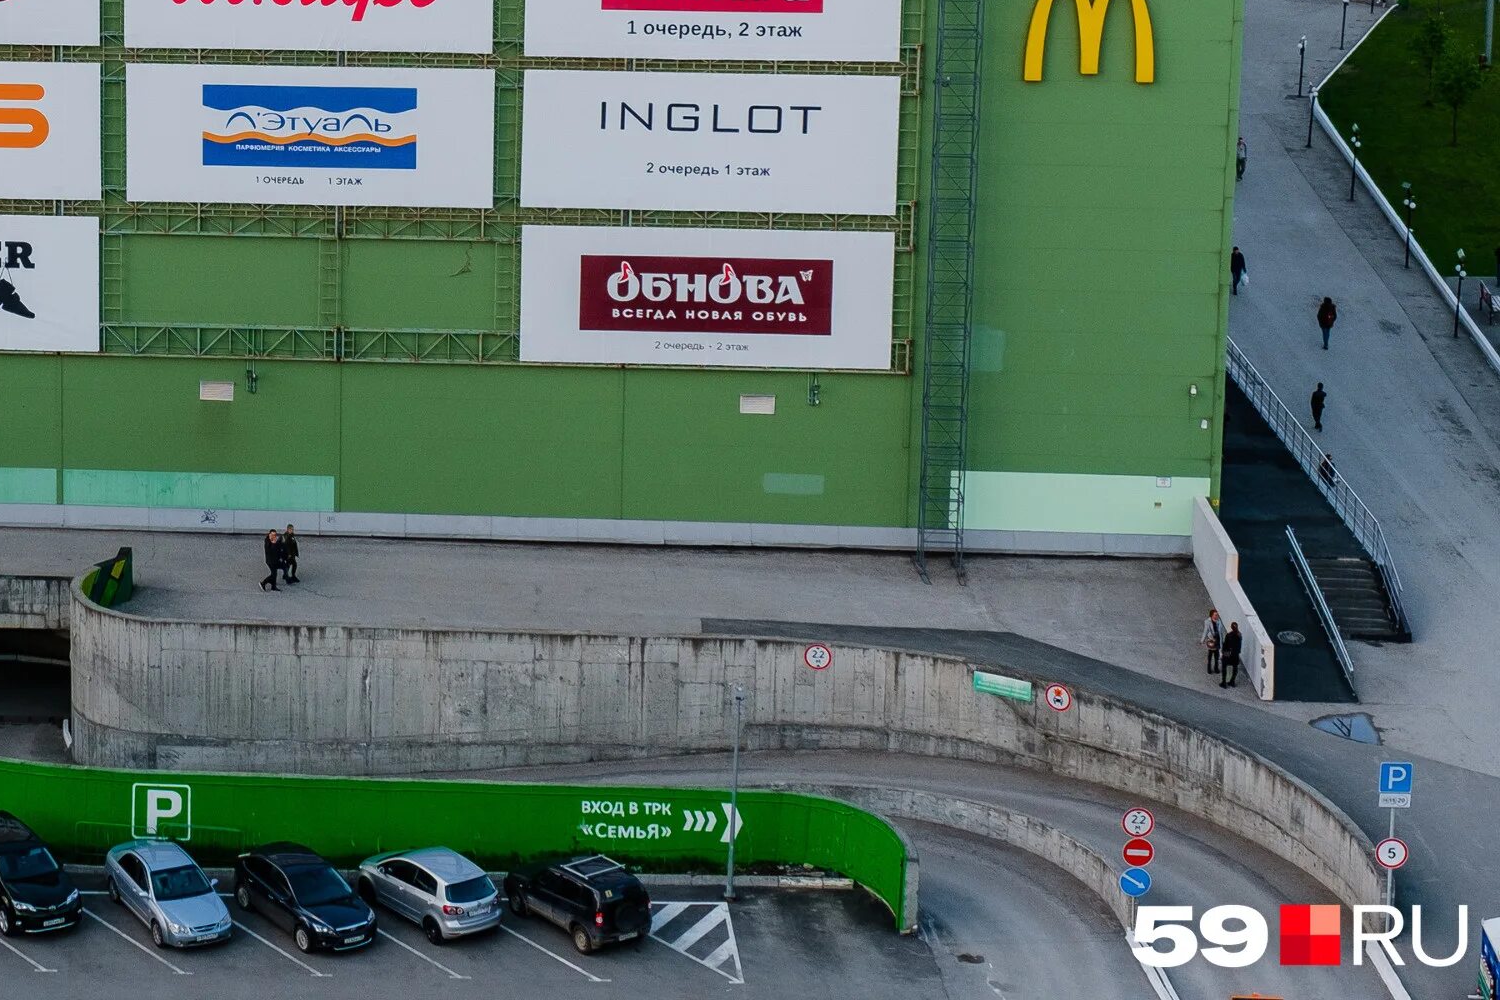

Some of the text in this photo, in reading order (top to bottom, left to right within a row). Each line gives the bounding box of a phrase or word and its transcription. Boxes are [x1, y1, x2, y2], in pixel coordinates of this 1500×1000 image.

[627, 20, 802, 39] 1 очередь, 2 этаж
[600, 101, 822, 135] INGLOT
[235, 144, 285, 152] ПАРФЮМЕРИЯ
[288, 145, 331, 153] КОСМЕТИКА
[646, 162, 771, 177] 2 очередь 1 этаж
[263, 176, 305, 185] ОЧЕРЕДЬ
[336, 177, 363, 186] ЭТАЖ
[606, 270, 805, 304] ОБНОВА
[612, 308, 807, 322] ВСЕГДА НОВАЯ ОБУВЬ
[654, 341, 749, 351] 2 очередь 2 этаж
[1388, 766, 1407, 790] P
[147, 789, 182, 834] P
[581, 800, 672, 818] ВХОД В ТРК
[1387, 847, 1396, 859] 5
